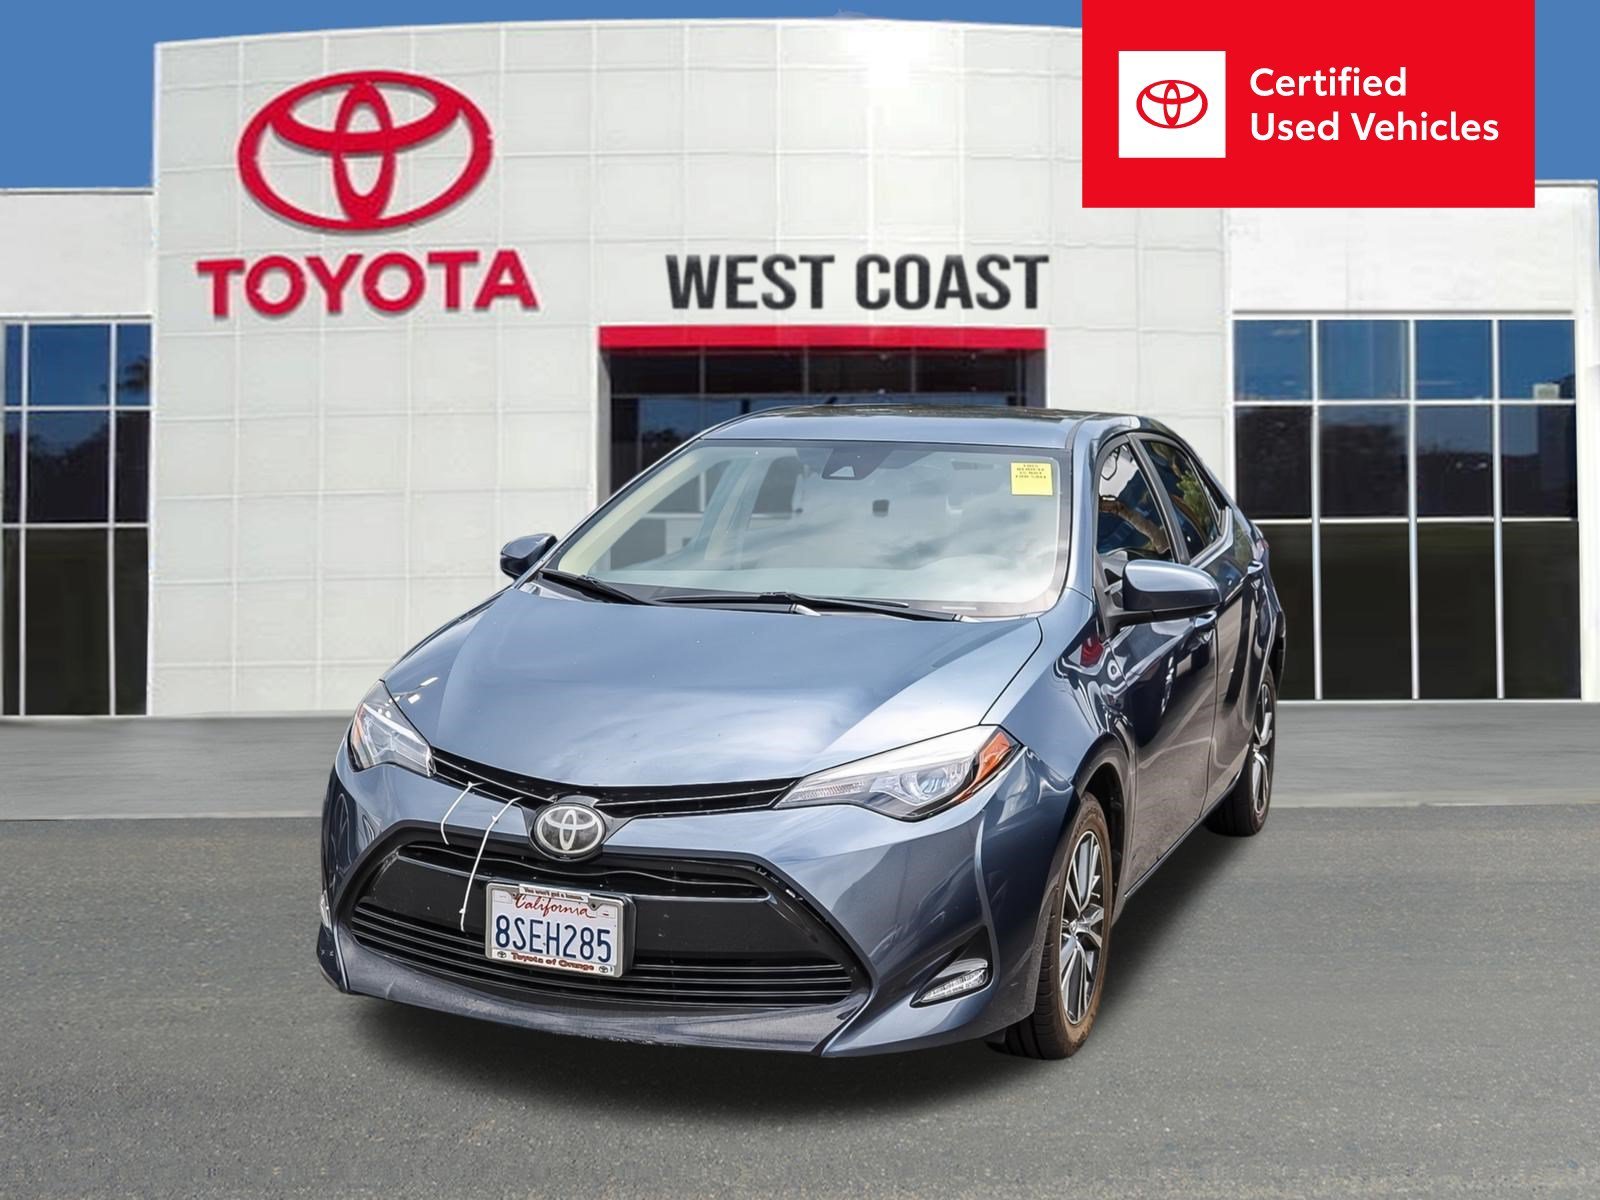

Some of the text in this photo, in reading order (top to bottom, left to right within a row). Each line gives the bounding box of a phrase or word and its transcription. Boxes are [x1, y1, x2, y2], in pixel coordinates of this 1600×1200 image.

[196, 249, 538, 317] TOYOTA
[666, 255, 1049, 310] WEST COAST
[513, 893, 597, 919] California
[495, 914, 612, 963] 8SEH285
[511, 952, 594, 971] Toyota of Orange
